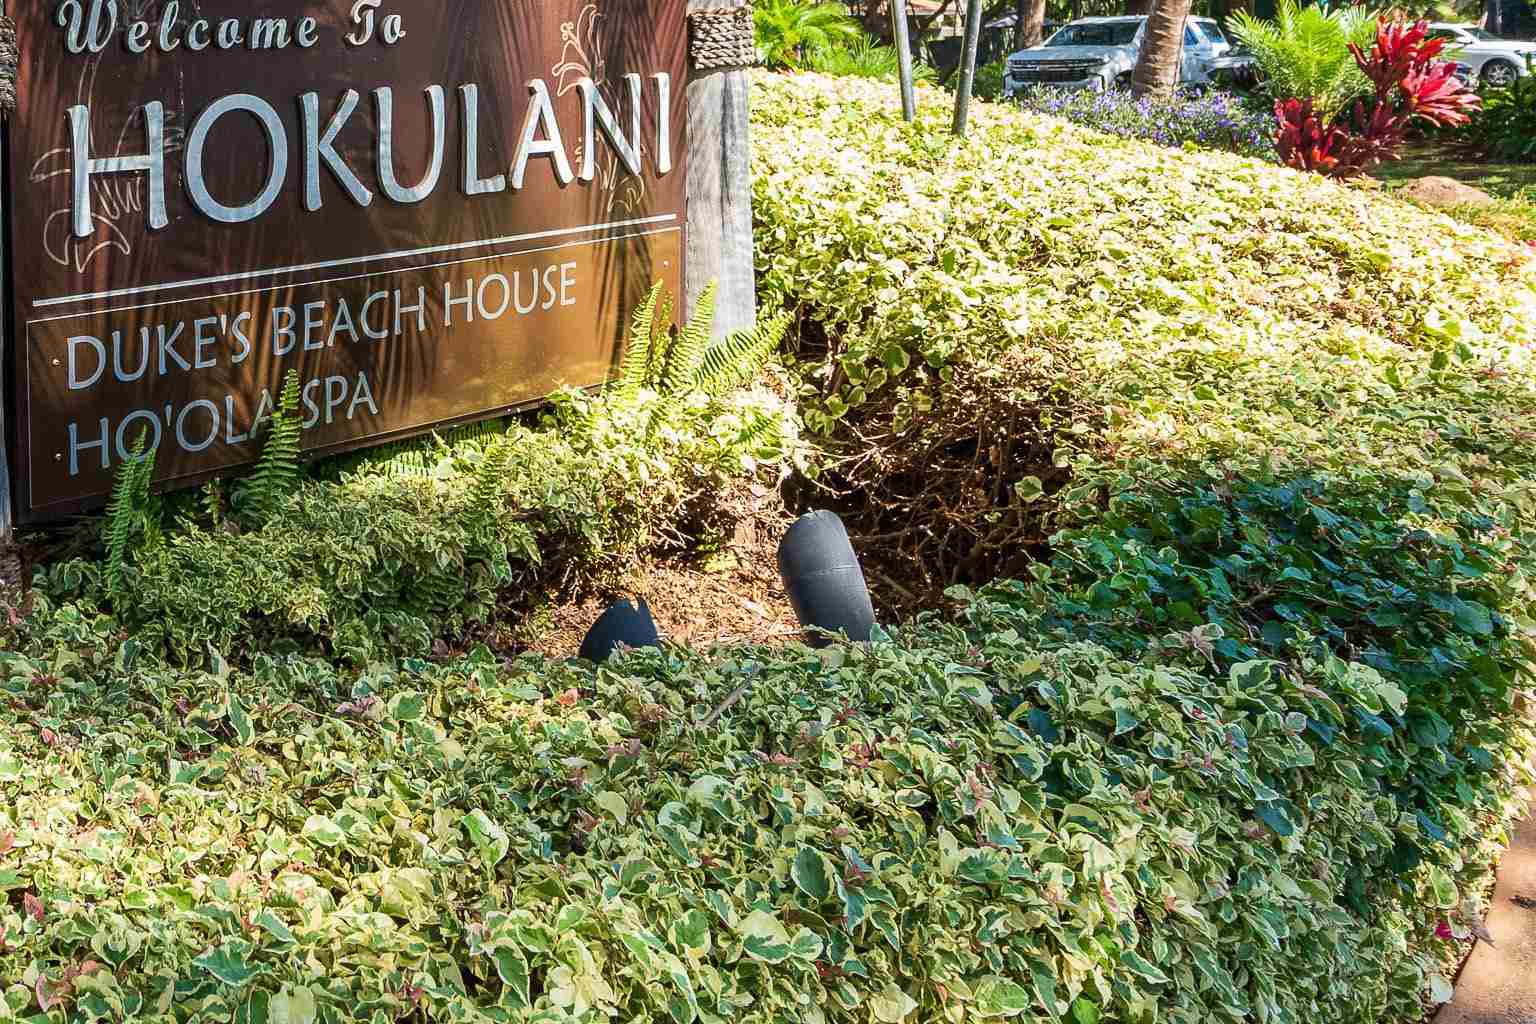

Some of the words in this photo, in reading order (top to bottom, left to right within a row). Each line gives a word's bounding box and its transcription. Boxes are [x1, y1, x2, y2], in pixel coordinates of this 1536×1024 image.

[59, 0, 320, 53] Welcome
[66, 73, 672, 237] HOKULANI
[67, 312, 252, 389] DUKE'S
[272, 286, 426, 357] BEACH
[444, 262, 577, 326] HOUSE
[301, 371, 379, 430] SPA
